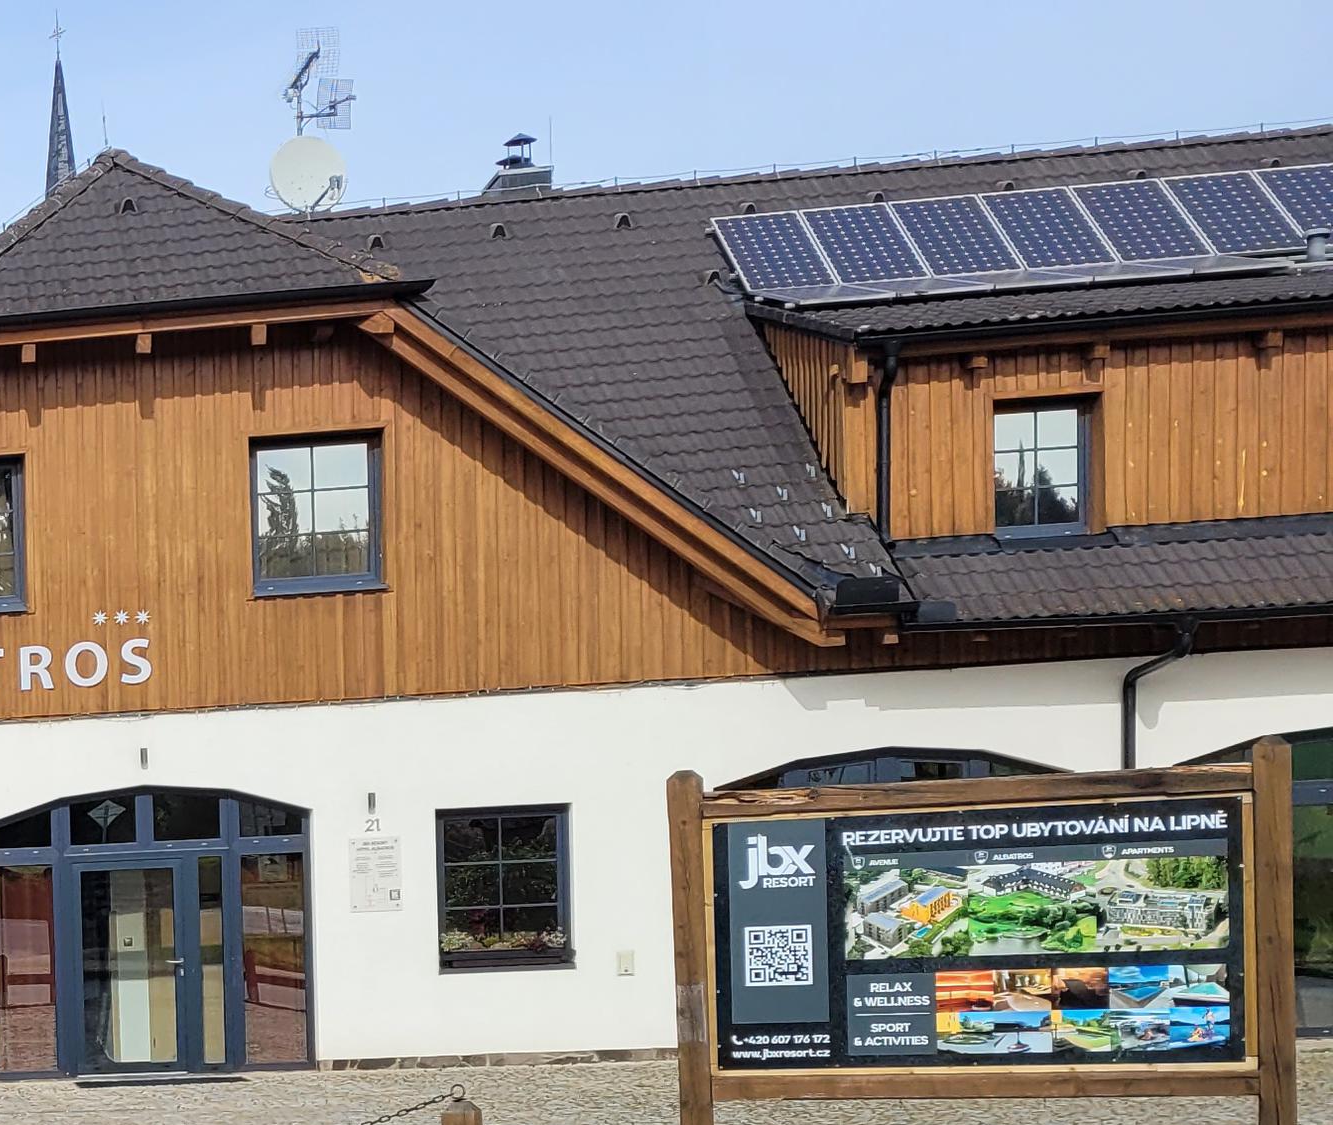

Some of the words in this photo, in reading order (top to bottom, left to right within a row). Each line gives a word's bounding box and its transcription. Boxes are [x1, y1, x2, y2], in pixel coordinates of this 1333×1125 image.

[364, 818, 381, 832] 21
[842, 826, 964, 846] REZERVUJTE
[967, 824, 1009, 840] TOP
[1012, 814, 1130, 838] UBYTOVÁNÍ
[1134, 817, 1166, 833] NA
[1170, 810, 1228, 831] LIPNĚ
[739, 833, 816, 889] jbx
[992, 852, 1034, 861] ALBATROS
[763, 876, 816, 888] RESORT
[870, 982, 912, 993] RELAX
[853, 997, 862, 1007] &
[864, 996, 930, 1007] WELLNESS
[870, 1022, 911, 1033] SPORT
[743, 1035, 770, 1044] +420
[771, 1035, 791, 1044] 607
[793, 1034, 810, 1043] 176
[812, 1034, 831, 1043] 172
[853, 1037, 862, 1046] &
[864, 1036, 929, 1046] ACTIVITIES
[732, 1048, 831, 1060] www.jbxresort.cz
